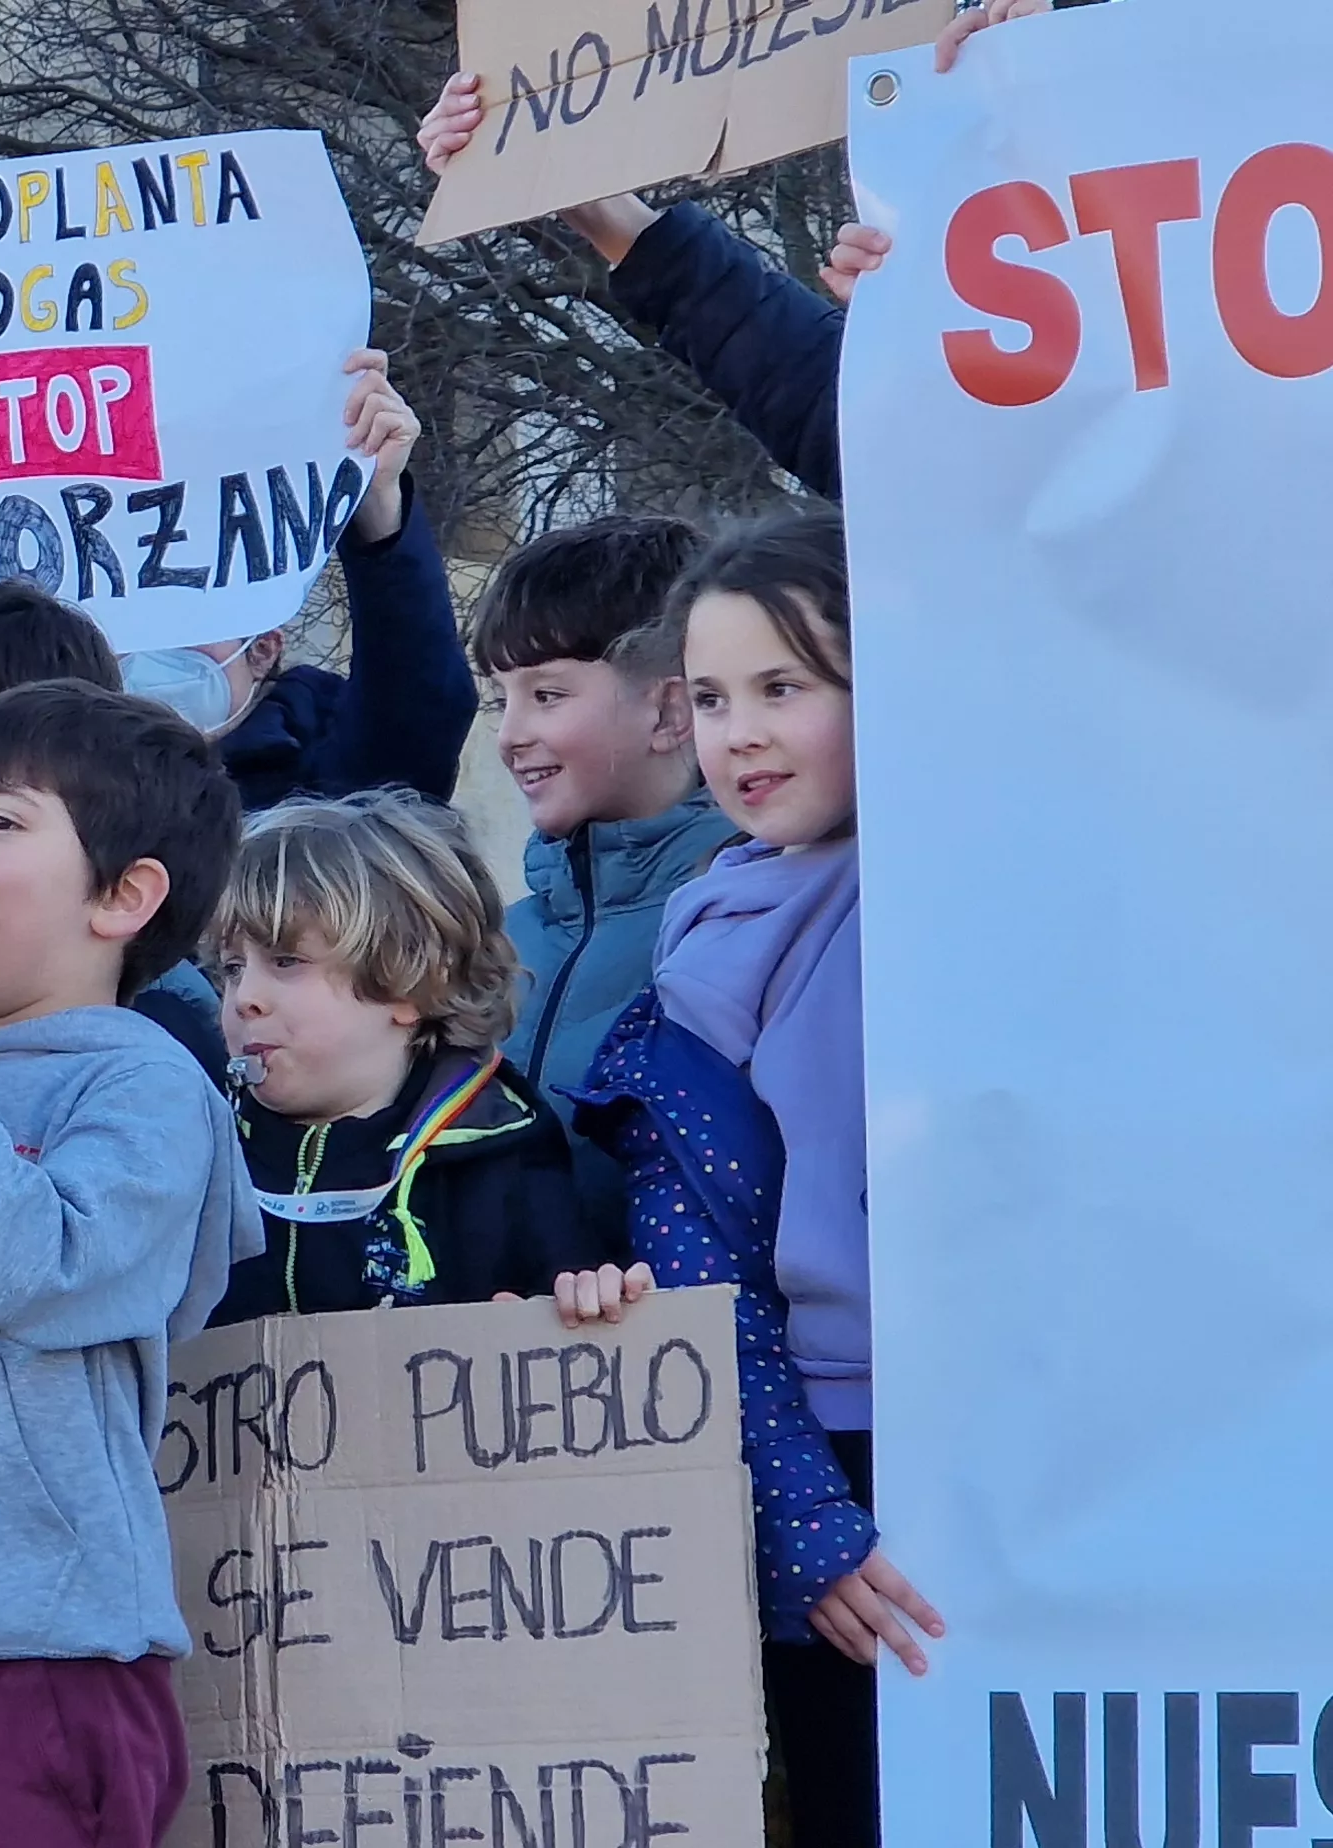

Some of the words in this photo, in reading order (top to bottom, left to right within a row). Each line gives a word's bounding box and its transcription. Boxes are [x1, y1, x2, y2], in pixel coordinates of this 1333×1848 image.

[496, 31, 611, 156] NO
[406, 1338, 712, 1472] PUEBLO
[203, 1540, 332, 1658] SE
[370, 1526, 678, 1644] VENDE
